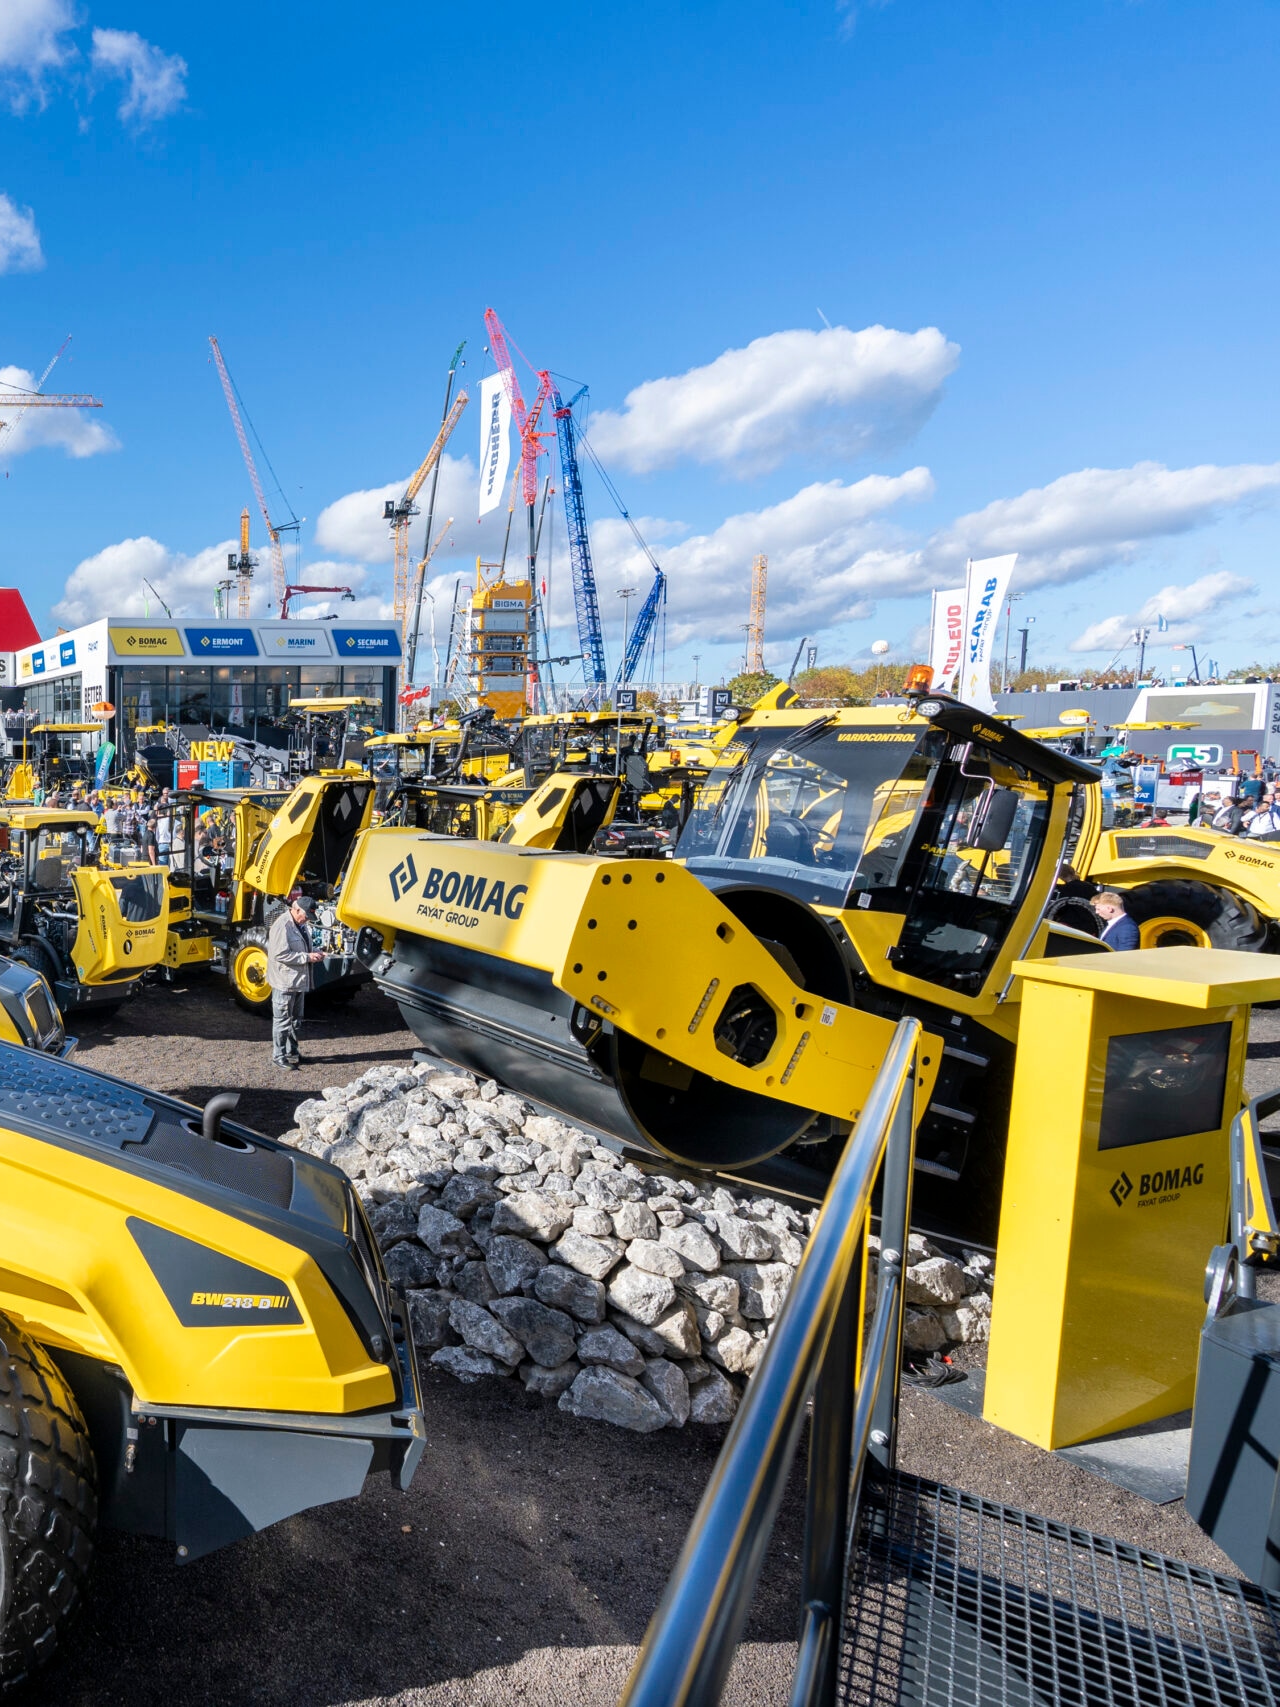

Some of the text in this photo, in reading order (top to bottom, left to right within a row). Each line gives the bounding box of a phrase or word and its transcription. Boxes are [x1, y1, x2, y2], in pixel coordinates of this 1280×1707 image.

[494, 600, 524, 608] SIGMA
[970, 577, 998, 664] SCARAB
[138, 637, 168, 645] BOMAG
[212, 638, 244, 646] ERMONT
[287, 638, 316, 646] MARINI
[357, 638, 389, 646] SECMAIR
[84, 685, 103, 704] BETTER
[837, 733, 917, 742] VARIOCONTROL
[980, 727, 1006, 743] BOMAG
[190, 741, 235, 762] NEW
[258, 850, 270, 875] BOMAG
[1238, 854, 1275, 869] BOMAG
[421, 867, 529, 920] BOMAG
[416, 904, 480, 929] FAYAT GROUP
[134, 928, 156, 936] BOMAG
[1139, 1163, 1205, 1196] BOMAG
[1137, 1193, 1182, 1208] FAYAT GROUP
[191, 1292, 271, 1309] BW 218 D
